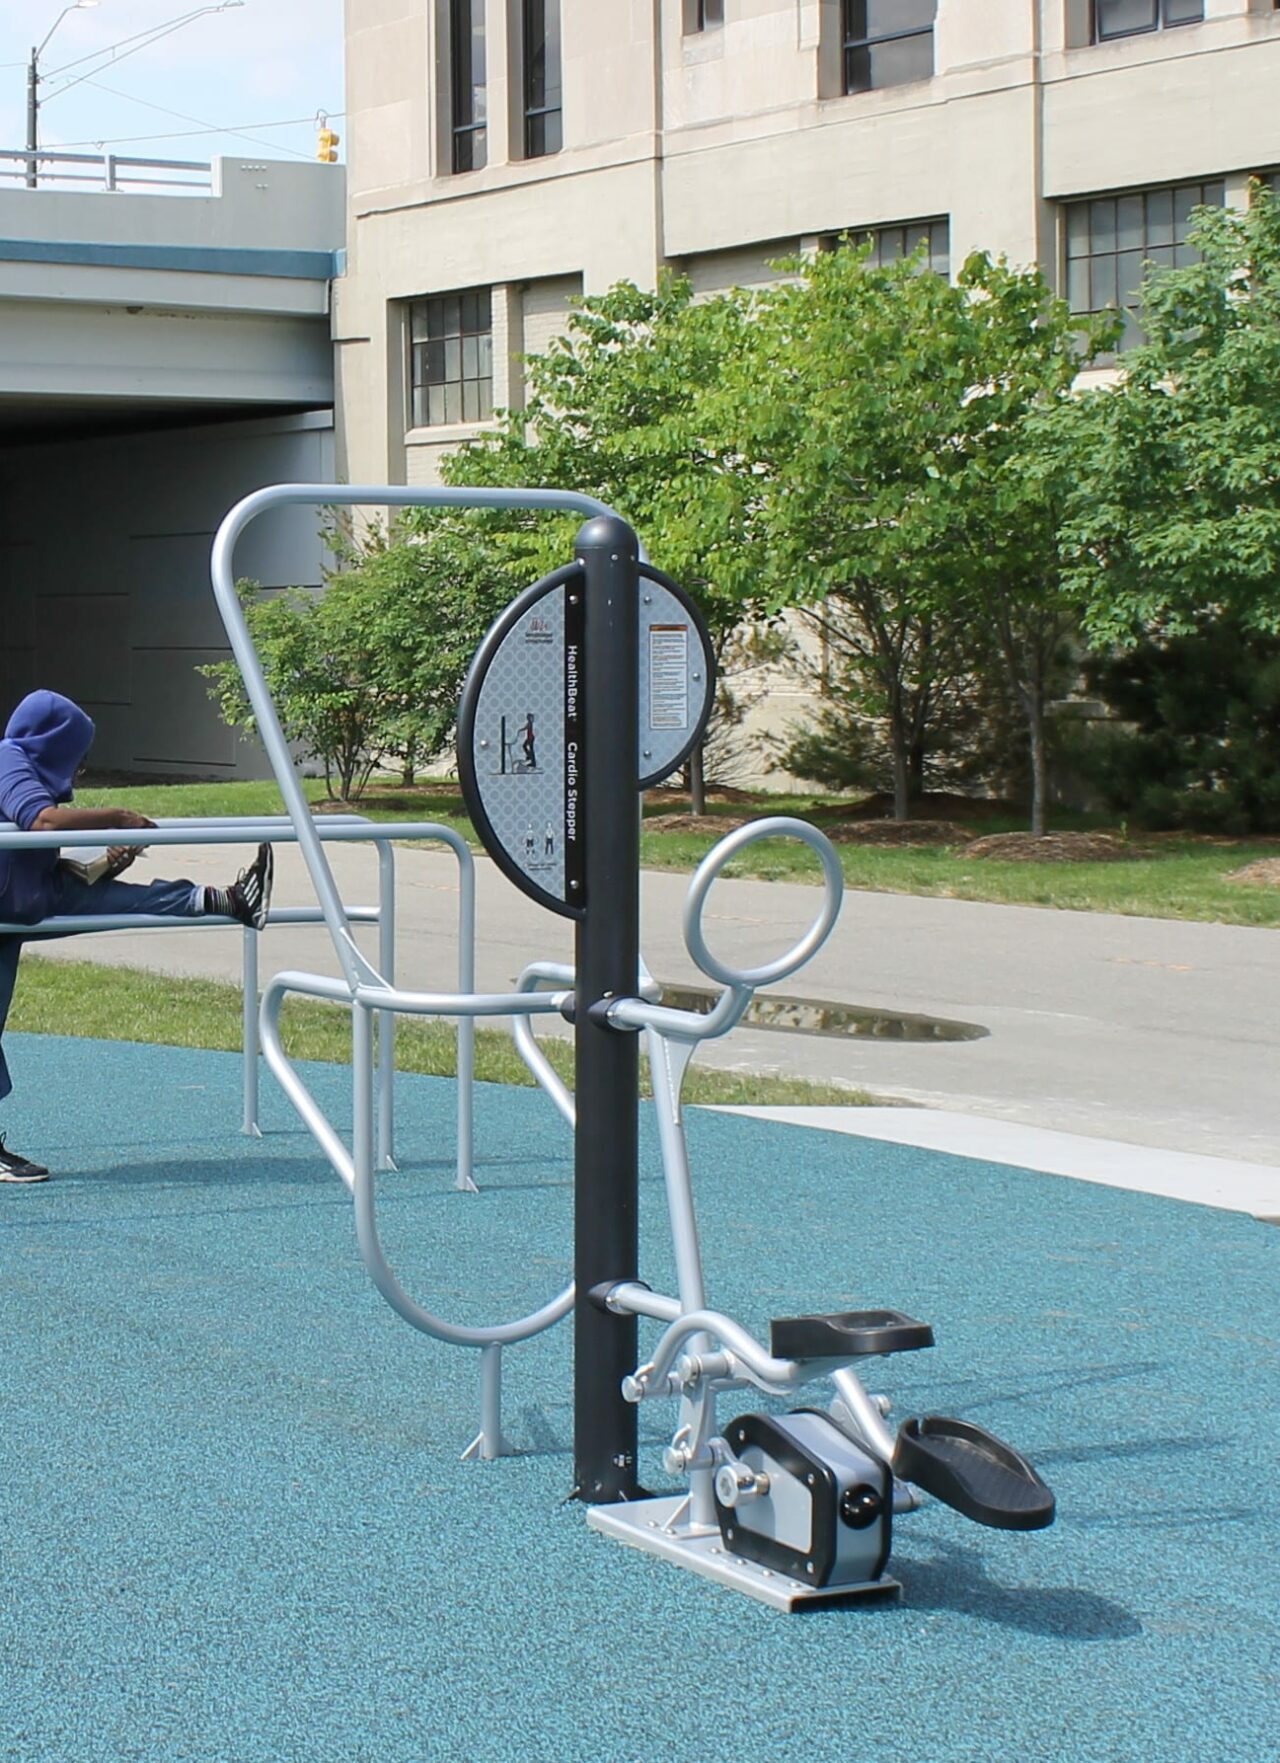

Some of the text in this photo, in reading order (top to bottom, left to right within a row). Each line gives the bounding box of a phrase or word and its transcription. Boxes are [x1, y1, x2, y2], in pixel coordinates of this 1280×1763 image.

[566, 645, 578, 841] HealthBeat Cardio Stepper
